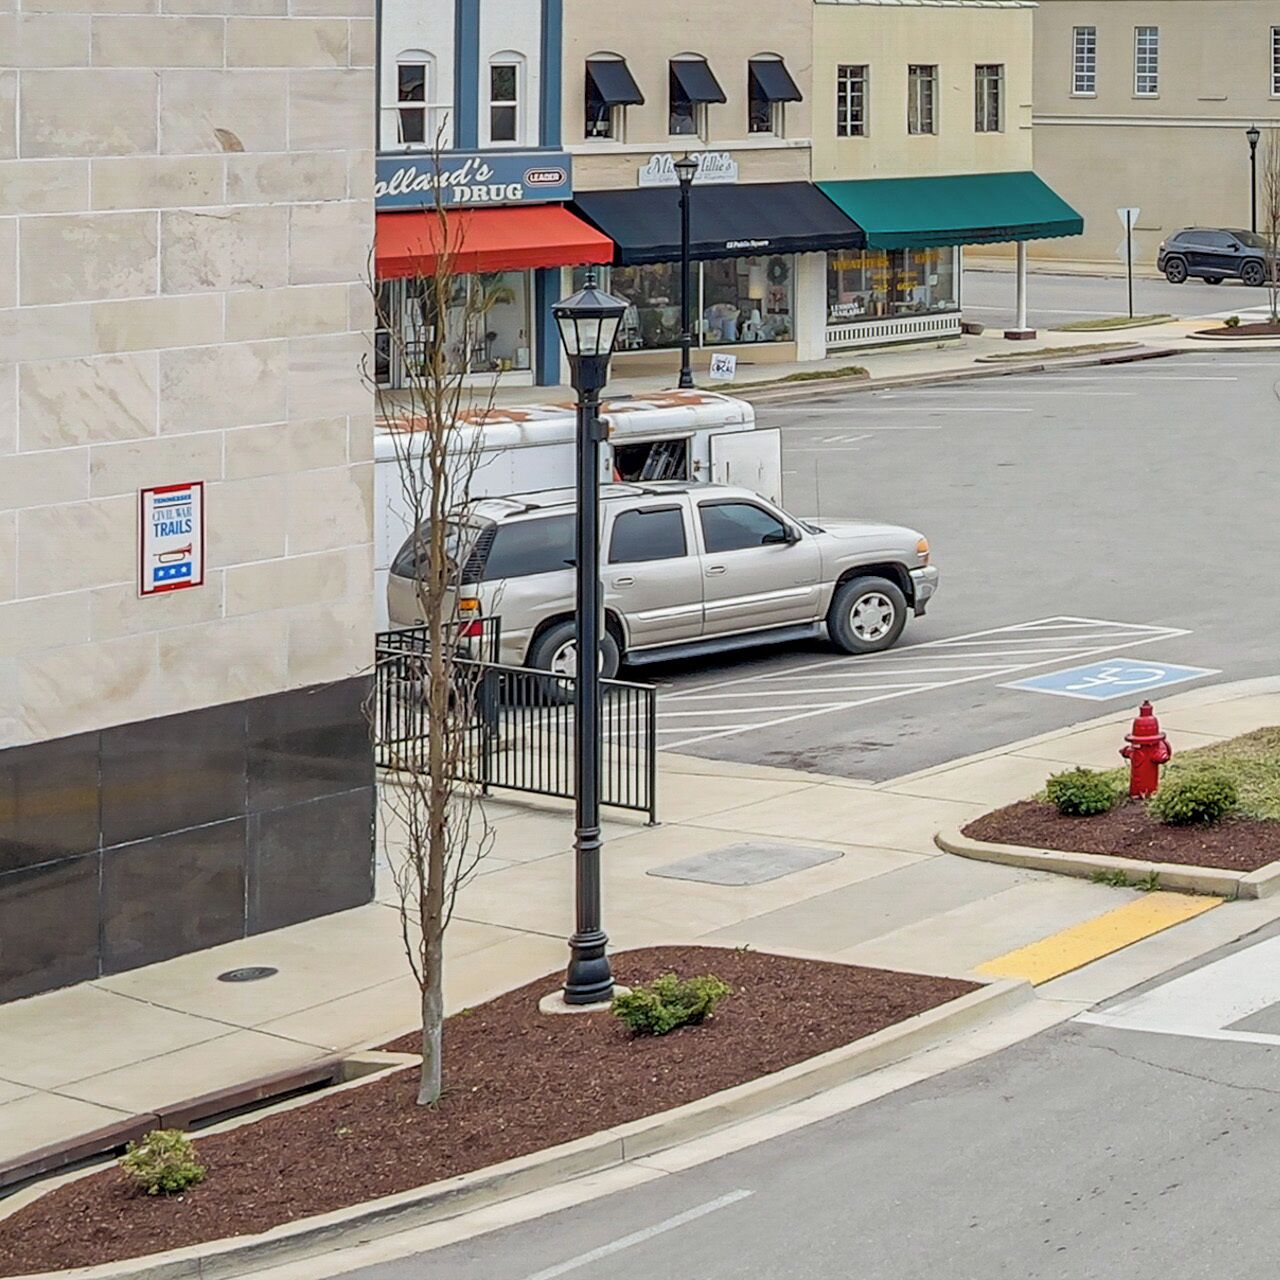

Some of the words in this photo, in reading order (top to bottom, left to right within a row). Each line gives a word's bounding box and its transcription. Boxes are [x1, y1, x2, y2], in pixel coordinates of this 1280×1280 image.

[375, 158, 494, 198] olland's
[529, 171, 560, 181] LEADER
[453, 183, 523, 202] DRUG
[153, 508, 174, 522] CIVIL
[175, 506, 192, 519] WAR
[153, 519, 192, 537] TRAILS
